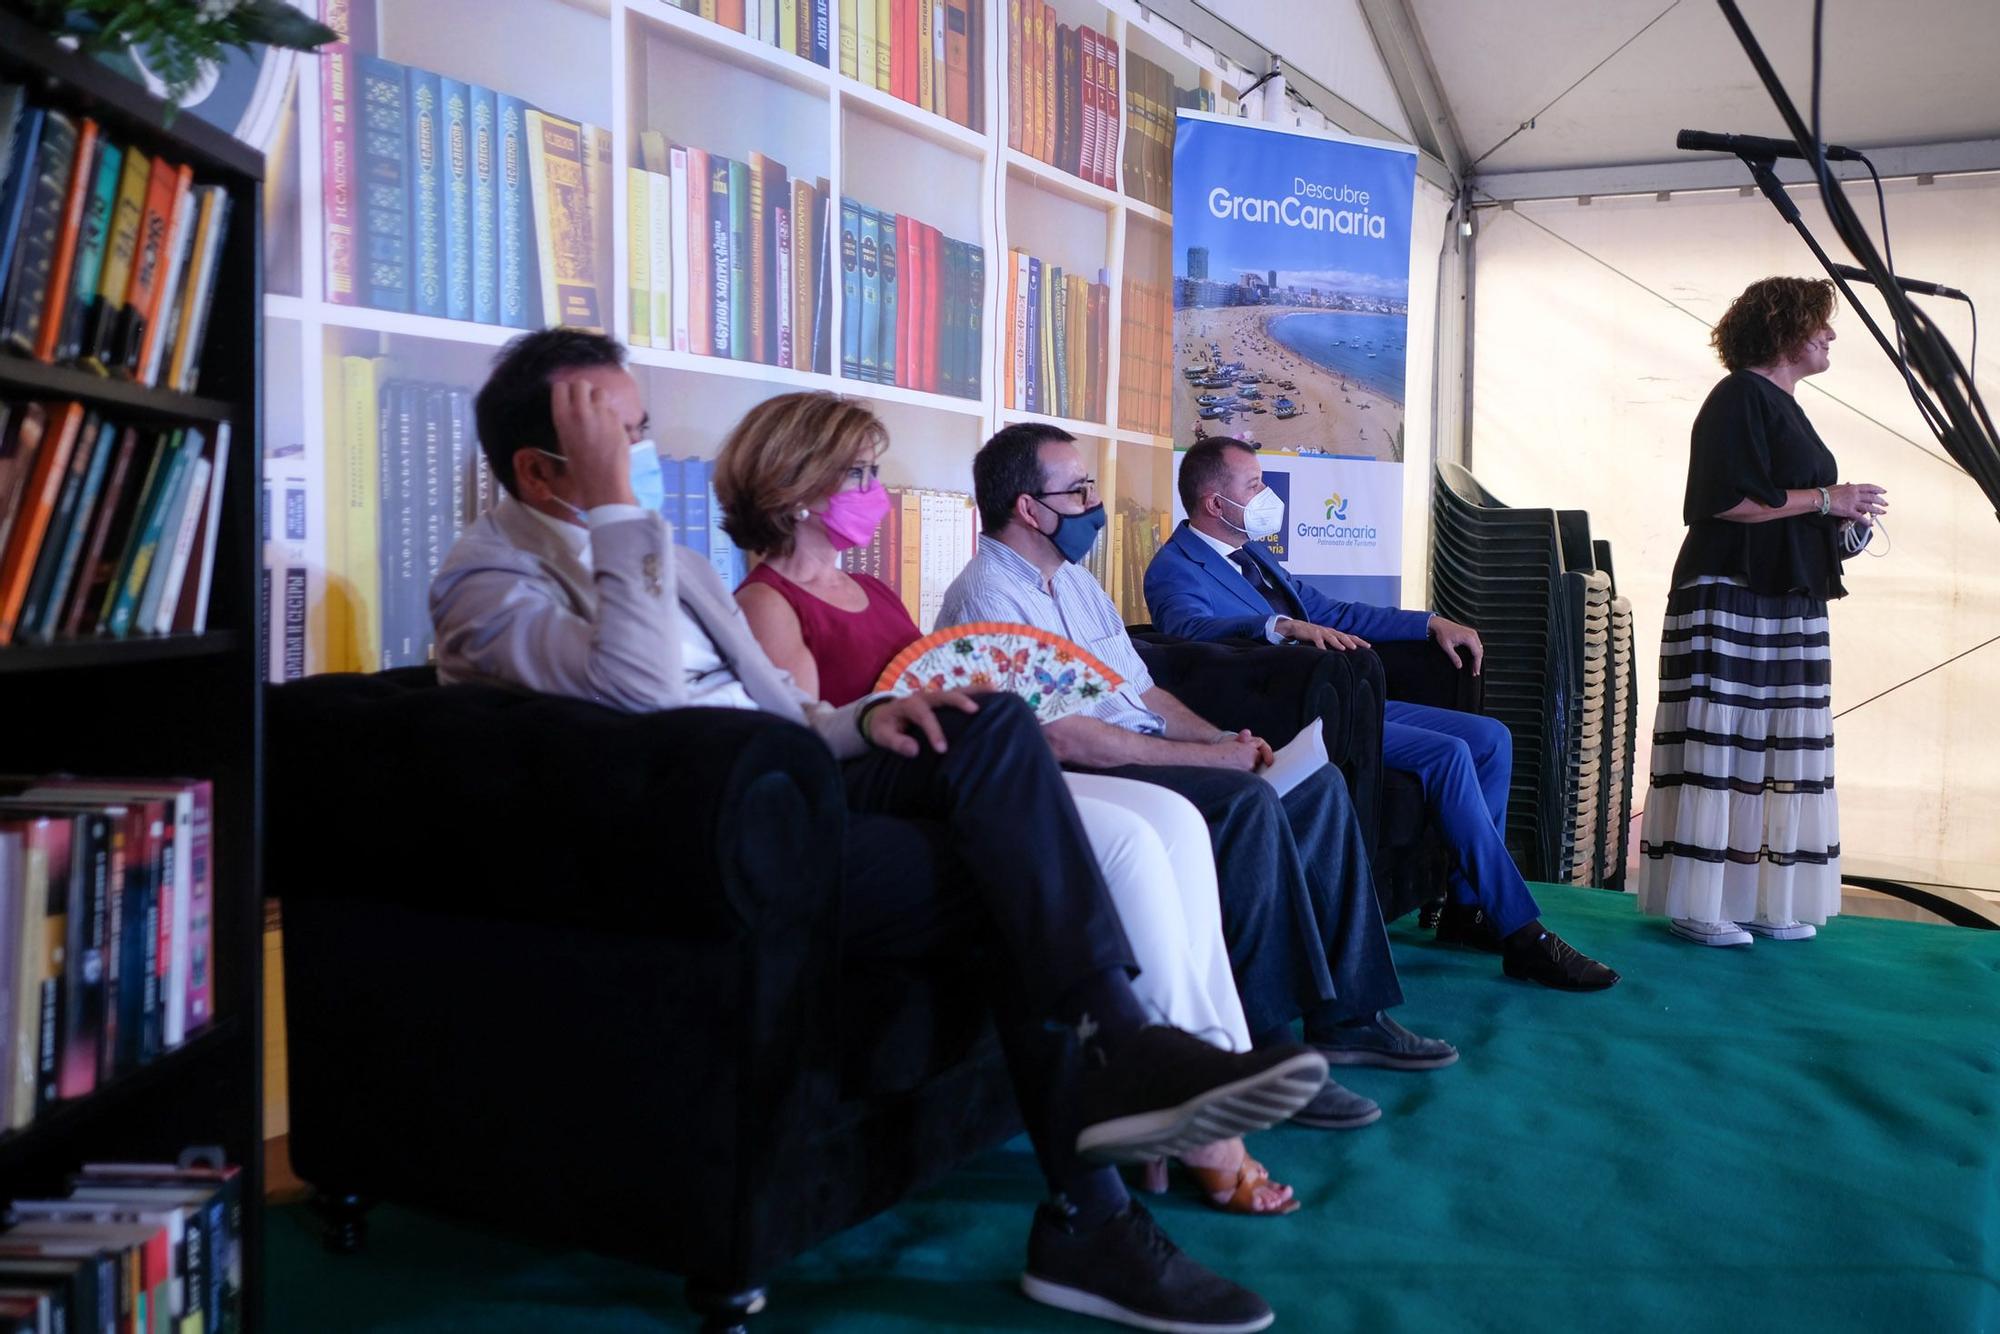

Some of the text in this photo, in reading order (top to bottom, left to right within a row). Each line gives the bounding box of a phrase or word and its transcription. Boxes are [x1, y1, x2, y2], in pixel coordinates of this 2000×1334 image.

[817, 16, 827, 50] АГАТА
[1208, 188, 1385, 239] GranCanaria
[1294, 177, 1370, 205] Descubre
[426, 421, 437, 506] САБАТИНИ
[451, 419, 462, 504] САБАТИНИ
[477, 453, 488, 500] САБАТ
[400, 413, 411, 578] РАФАЭЛЬ САБАТИНИ
[1297, 523, 1377, 539] GranCanaria
